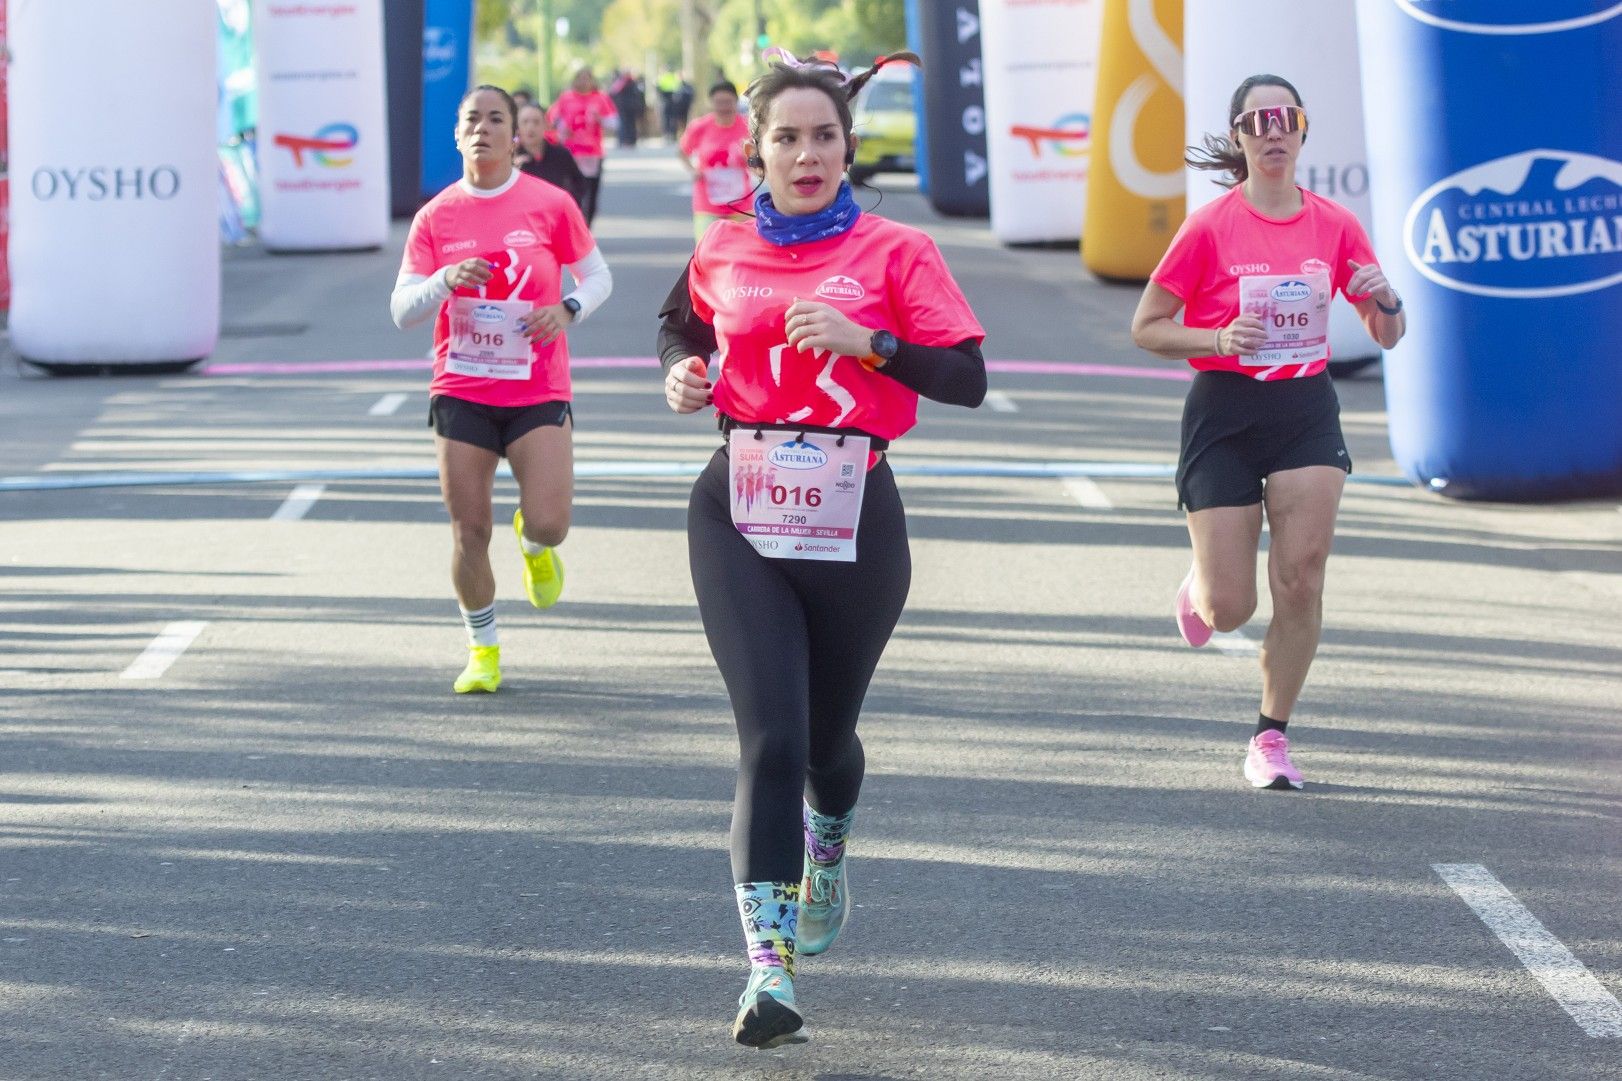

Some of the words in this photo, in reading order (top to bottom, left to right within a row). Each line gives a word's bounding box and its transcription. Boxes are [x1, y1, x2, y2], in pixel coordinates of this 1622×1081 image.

[31, 164, 182, 202] OYSHO
[1457, 198, 1557, 220] CENTRAL
[1229, 263, 1270, 275] OYSHO
[1274, 289, 1309, 298] ASTURIANA
[1274, 312, 1309, 328] 016
[471, 332, 504, 346] 016
[740, 453, 764, 462] SUMA
[773, 450, 823, 464] ASTURIANA
[770, 485, 822, 507] 016
[782, 514, 807, 525] 7290
[747, 525, 770, 534] CARRERA
[771, 526, 780, 534] DE
[803, 543, 840, 553] Santander
